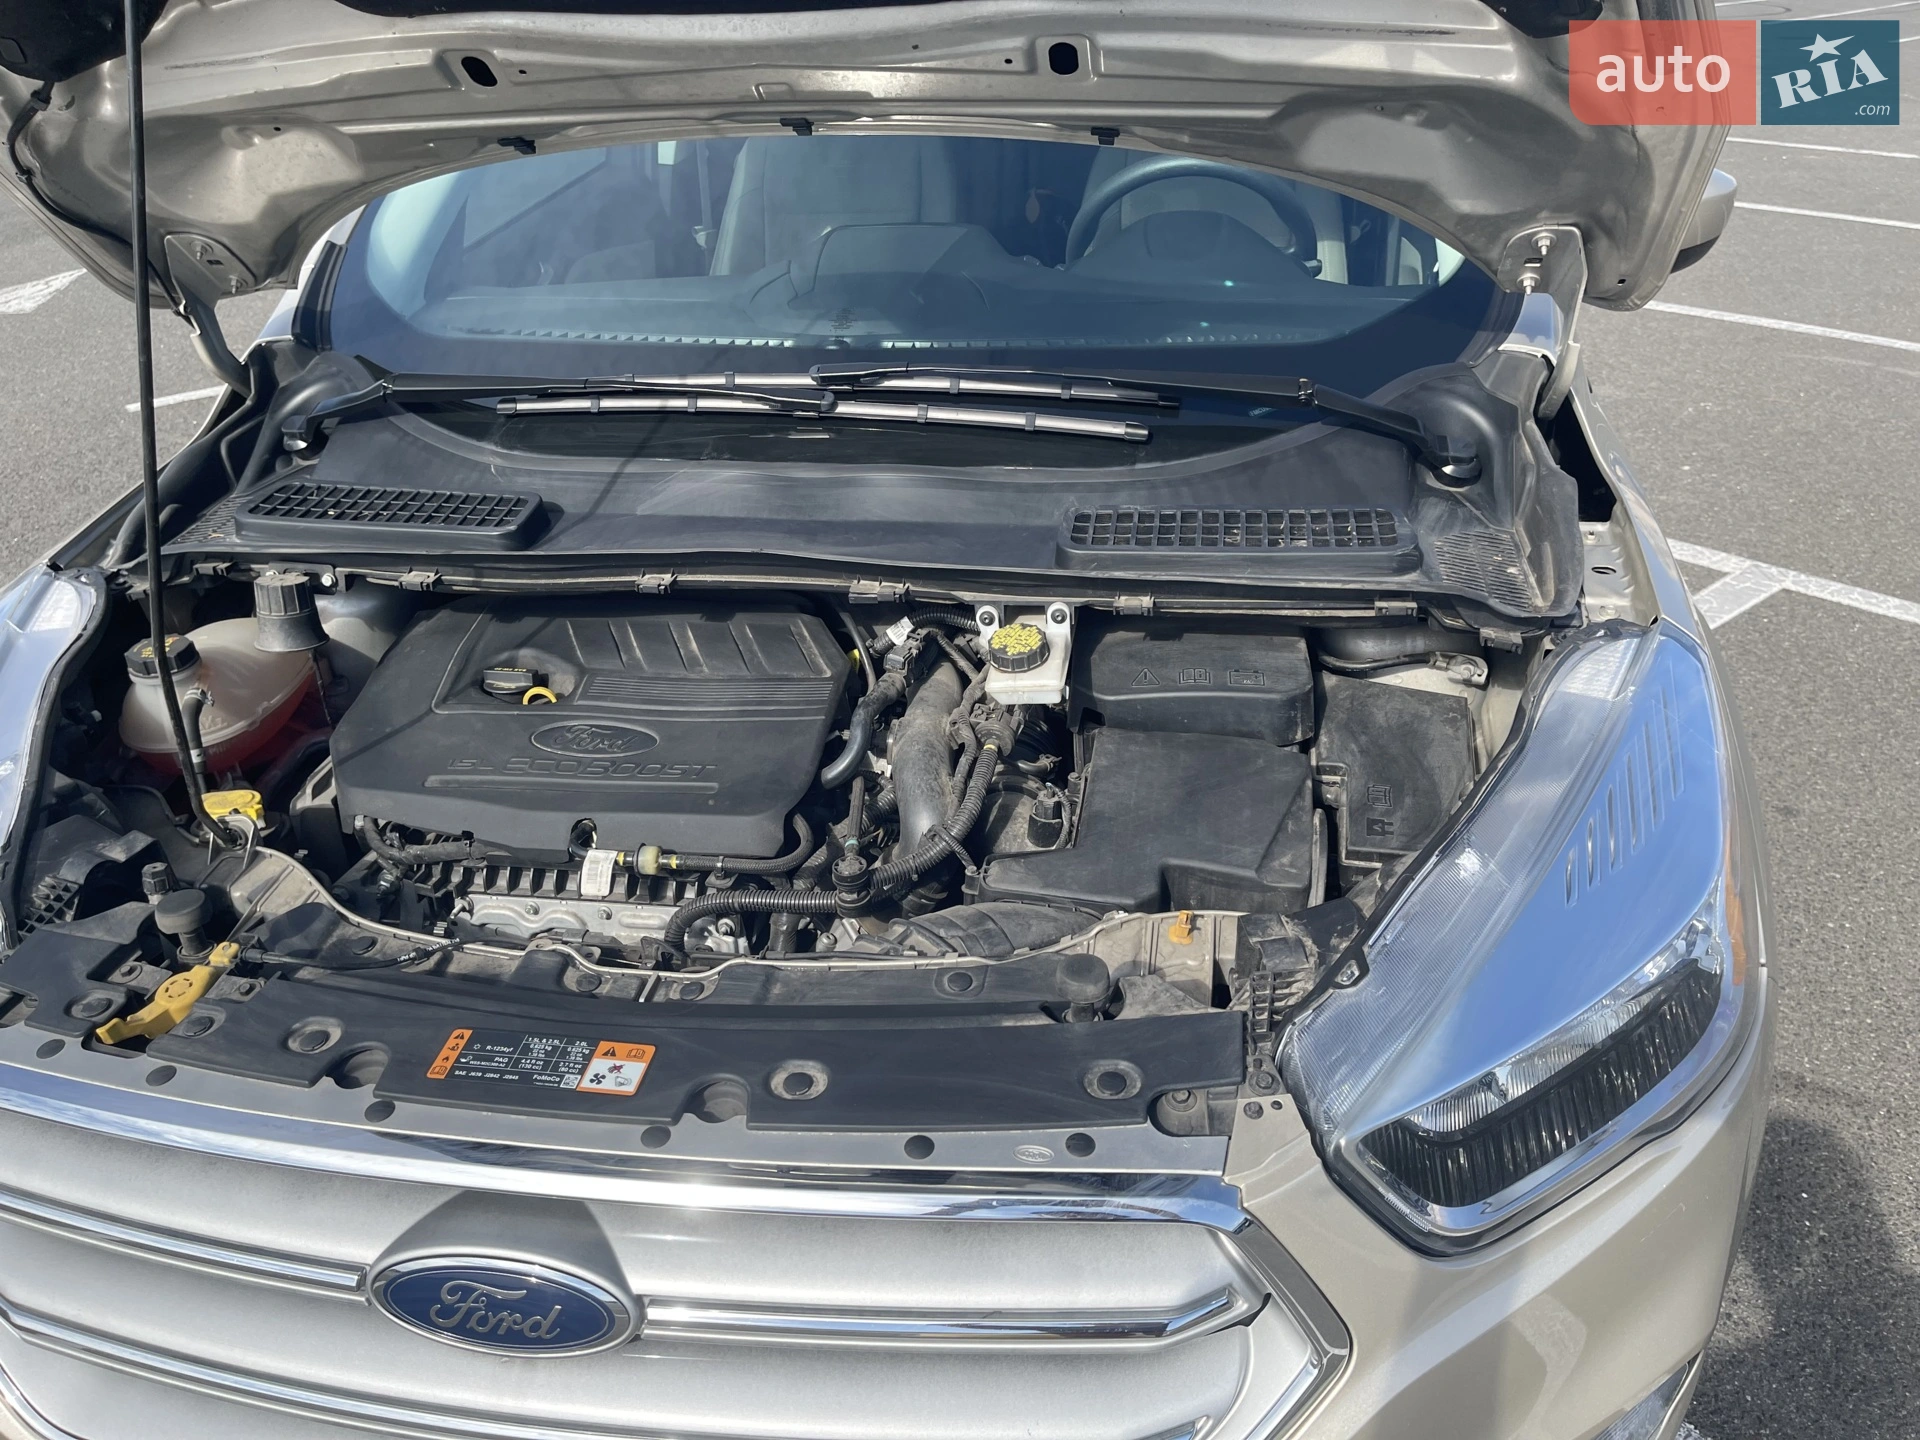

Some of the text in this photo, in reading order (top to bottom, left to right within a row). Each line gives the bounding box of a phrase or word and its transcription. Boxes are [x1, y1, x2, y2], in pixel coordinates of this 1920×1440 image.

[553, 724, 639, 752] Ford
[485, 1045, 514, 1053] R-1234yf
[532, 1074, 560, 1082] FoMoCo
[429, 1280, 562, 1340] Ford
